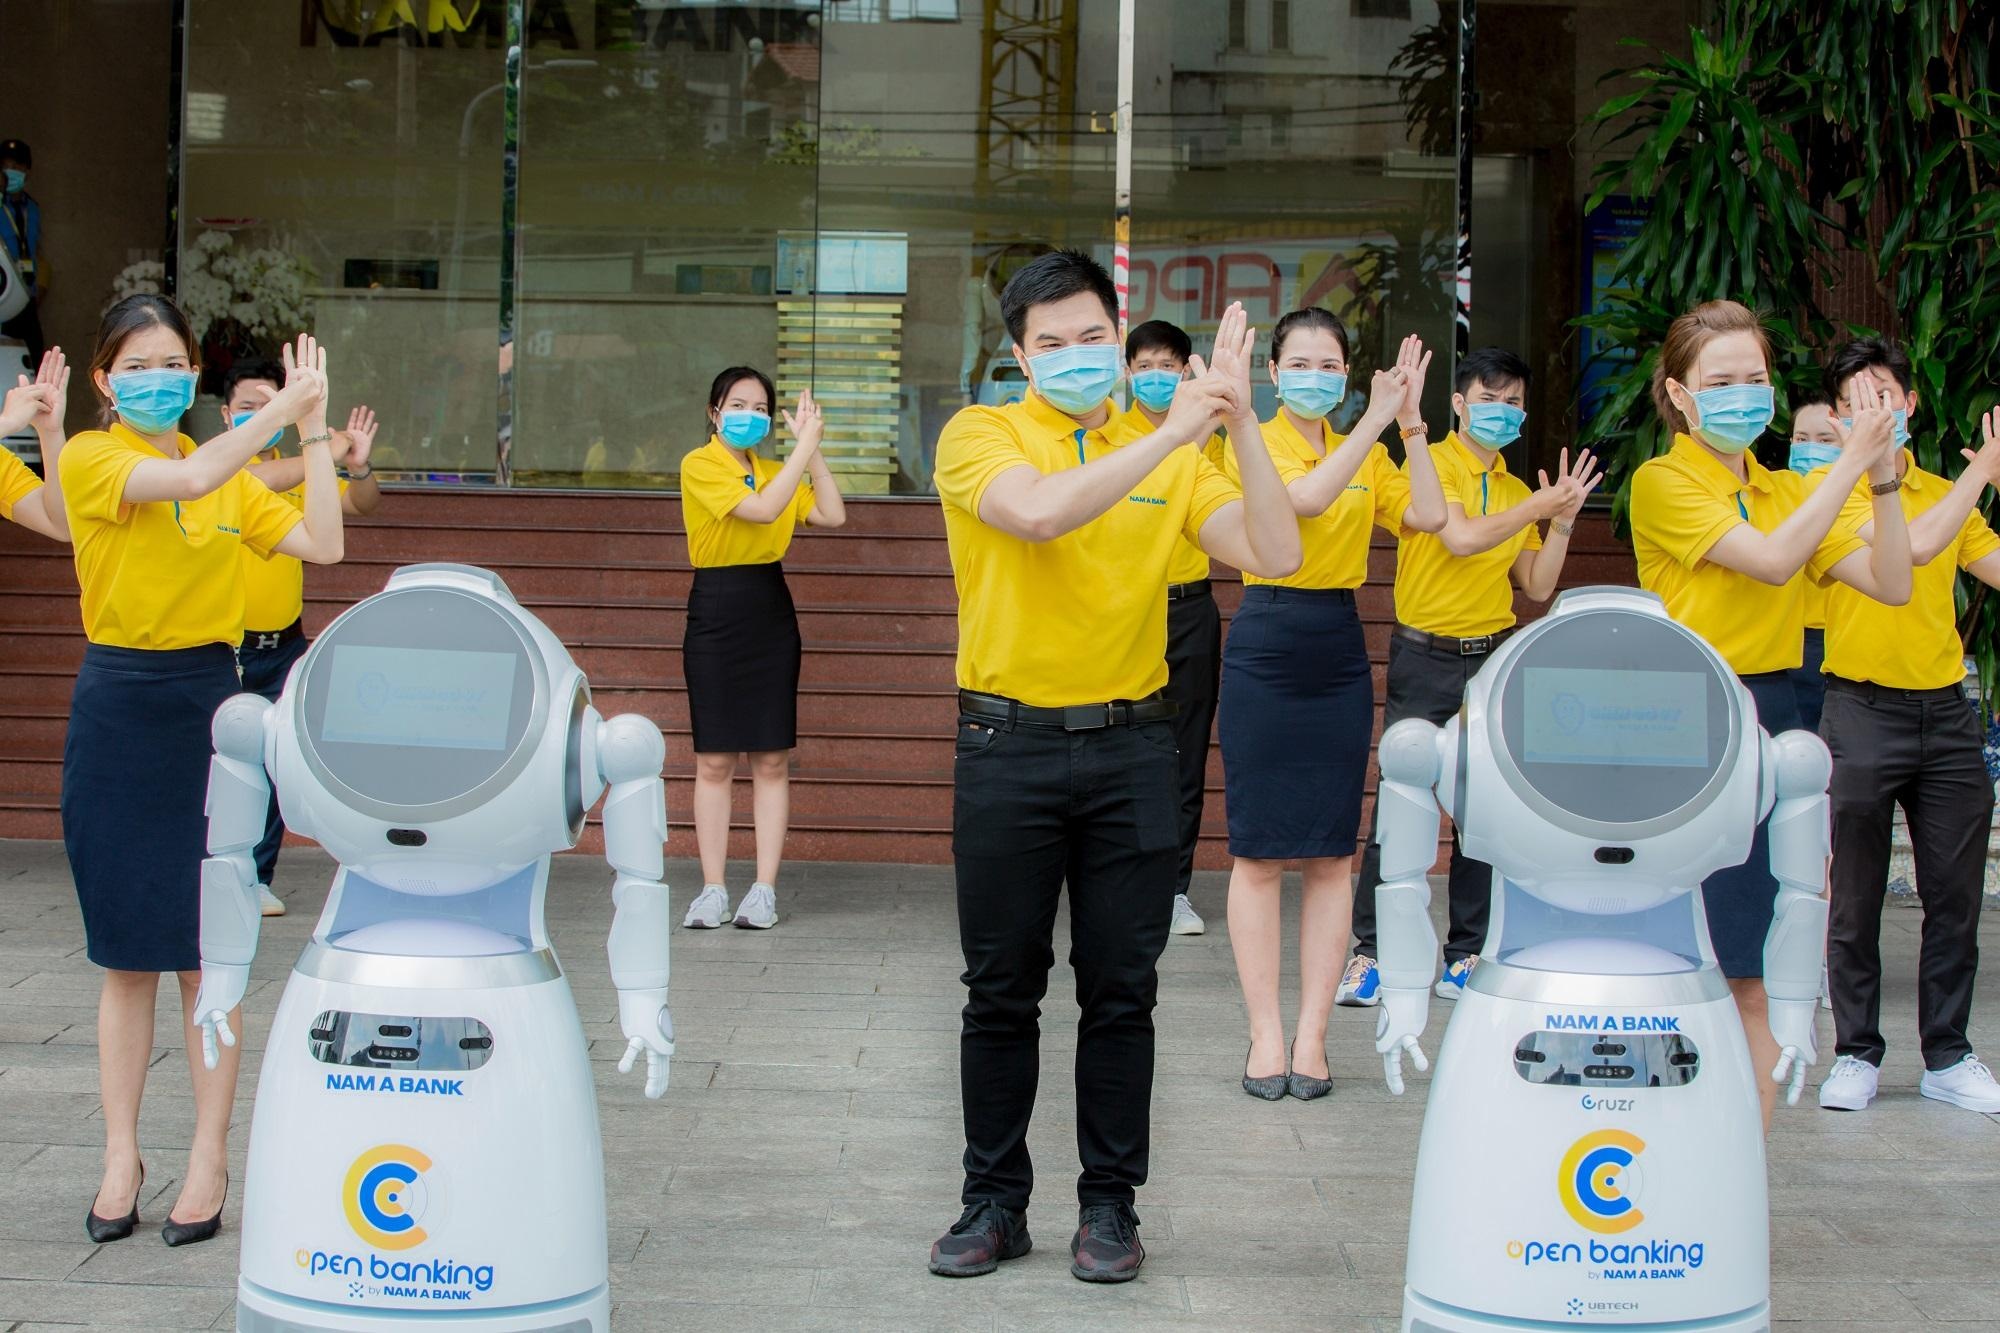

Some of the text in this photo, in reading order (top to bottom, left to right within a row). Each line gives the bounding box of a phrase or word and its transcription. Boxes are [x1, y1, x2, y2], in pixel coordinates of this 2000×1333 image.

[1129, 495, 1146, 503] NAM
[1545, 1014, 1680, 1031] NAM A BANK
[326, 1074, 464, 1096] NAM A BANK
[1507, 1239, 1704, 1268] open banking
[295, 1248, 494, 1292] open banking
[1588, 1268, 1686, 1280] by NAM A BANK
[368, 1286, 472, 1300] by NAM A BANK
[1587, 1302, 1639, 1310] UBTECH
